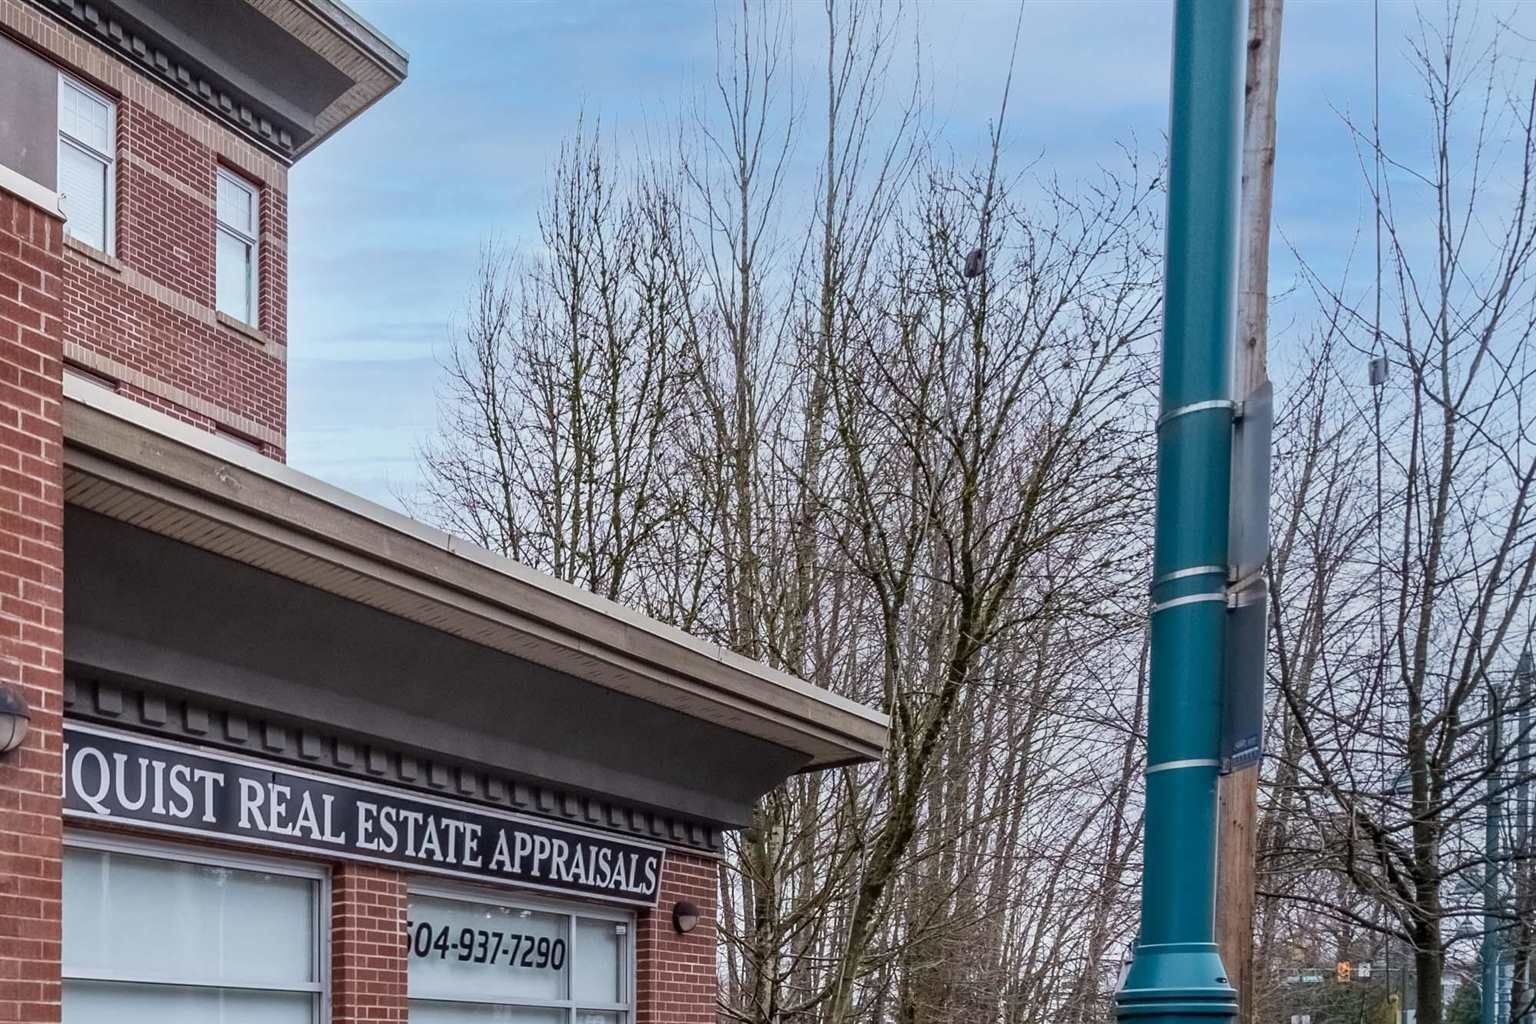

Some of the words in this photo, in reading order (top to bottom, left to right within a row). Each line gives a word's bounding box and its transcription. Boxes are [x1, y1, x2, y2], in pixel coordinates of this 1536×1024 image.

[63, 742, 224, 823] QUIST
[238, 777, 345, 844] REAL
[356, 801, 482, 868] ESTATE
[489, 828, 657, 896] APPRAISALS
